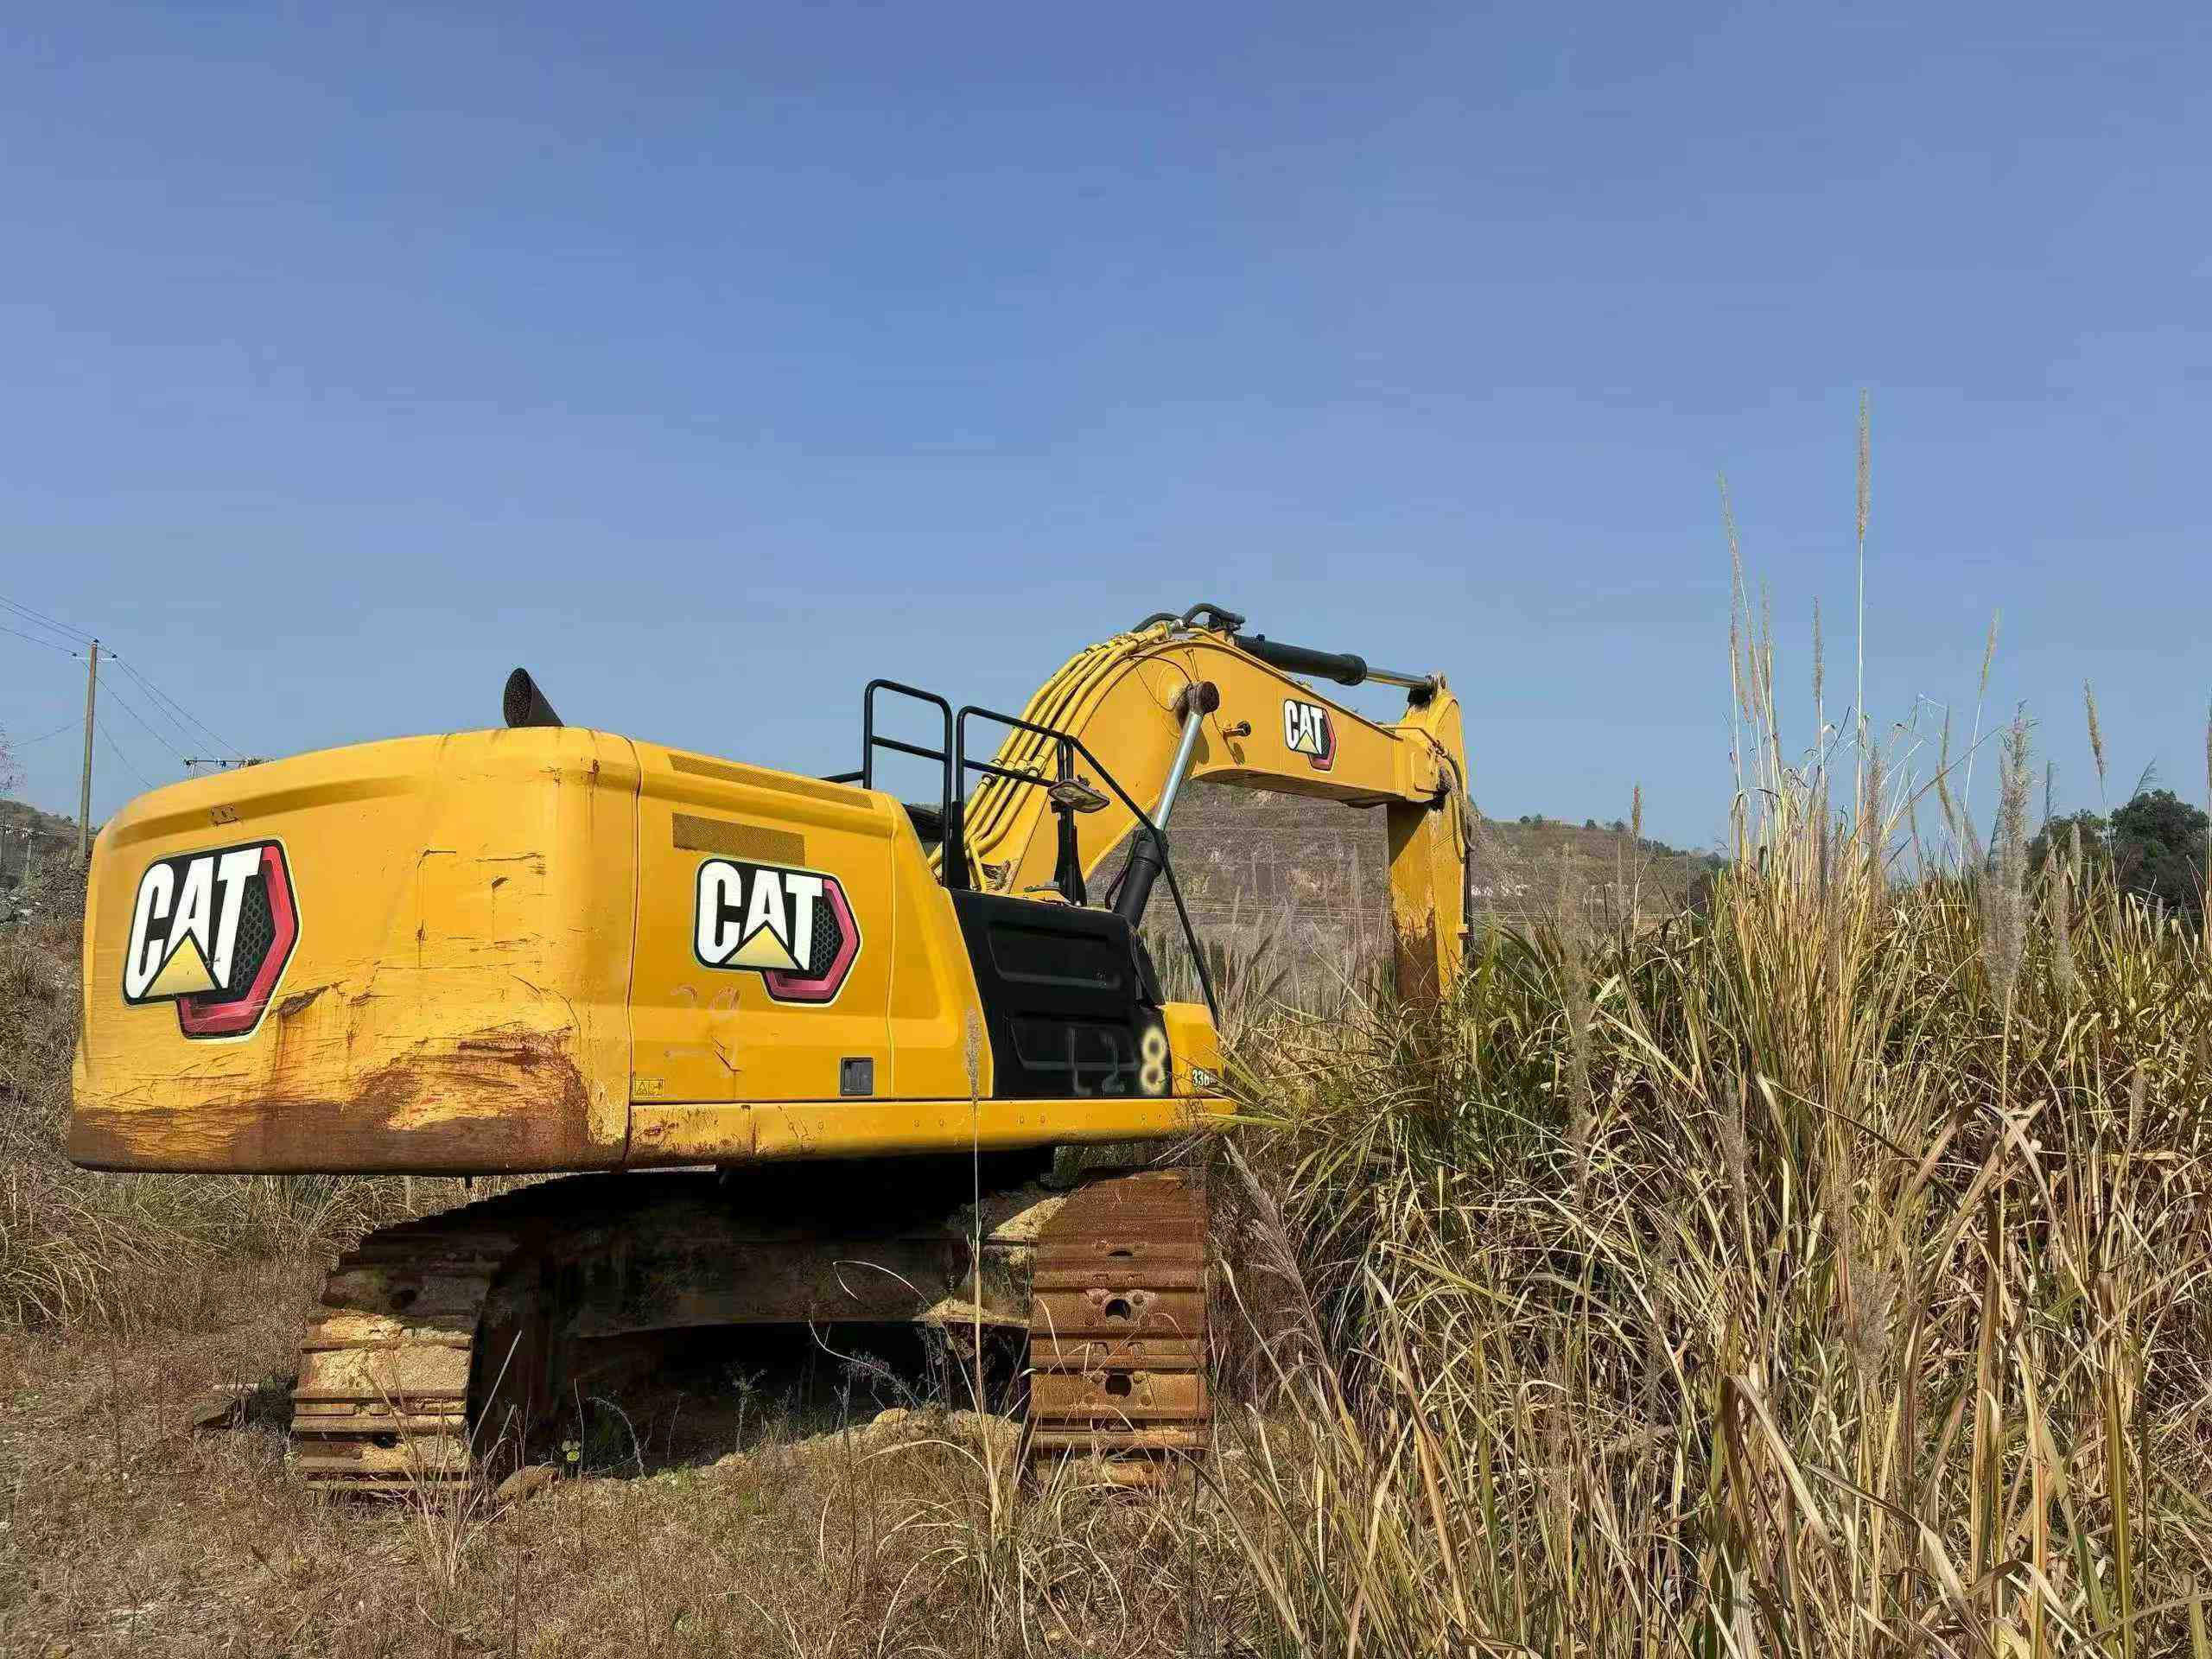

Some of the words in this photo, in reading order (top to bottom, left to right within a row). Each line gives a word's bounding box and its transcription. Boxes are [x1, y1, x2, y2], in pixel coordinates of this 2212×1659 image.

[1284, 700, 1324, 755] CAT
[124, 847, 263, 999] CAT
[698, 861, 823, 970] CAT
